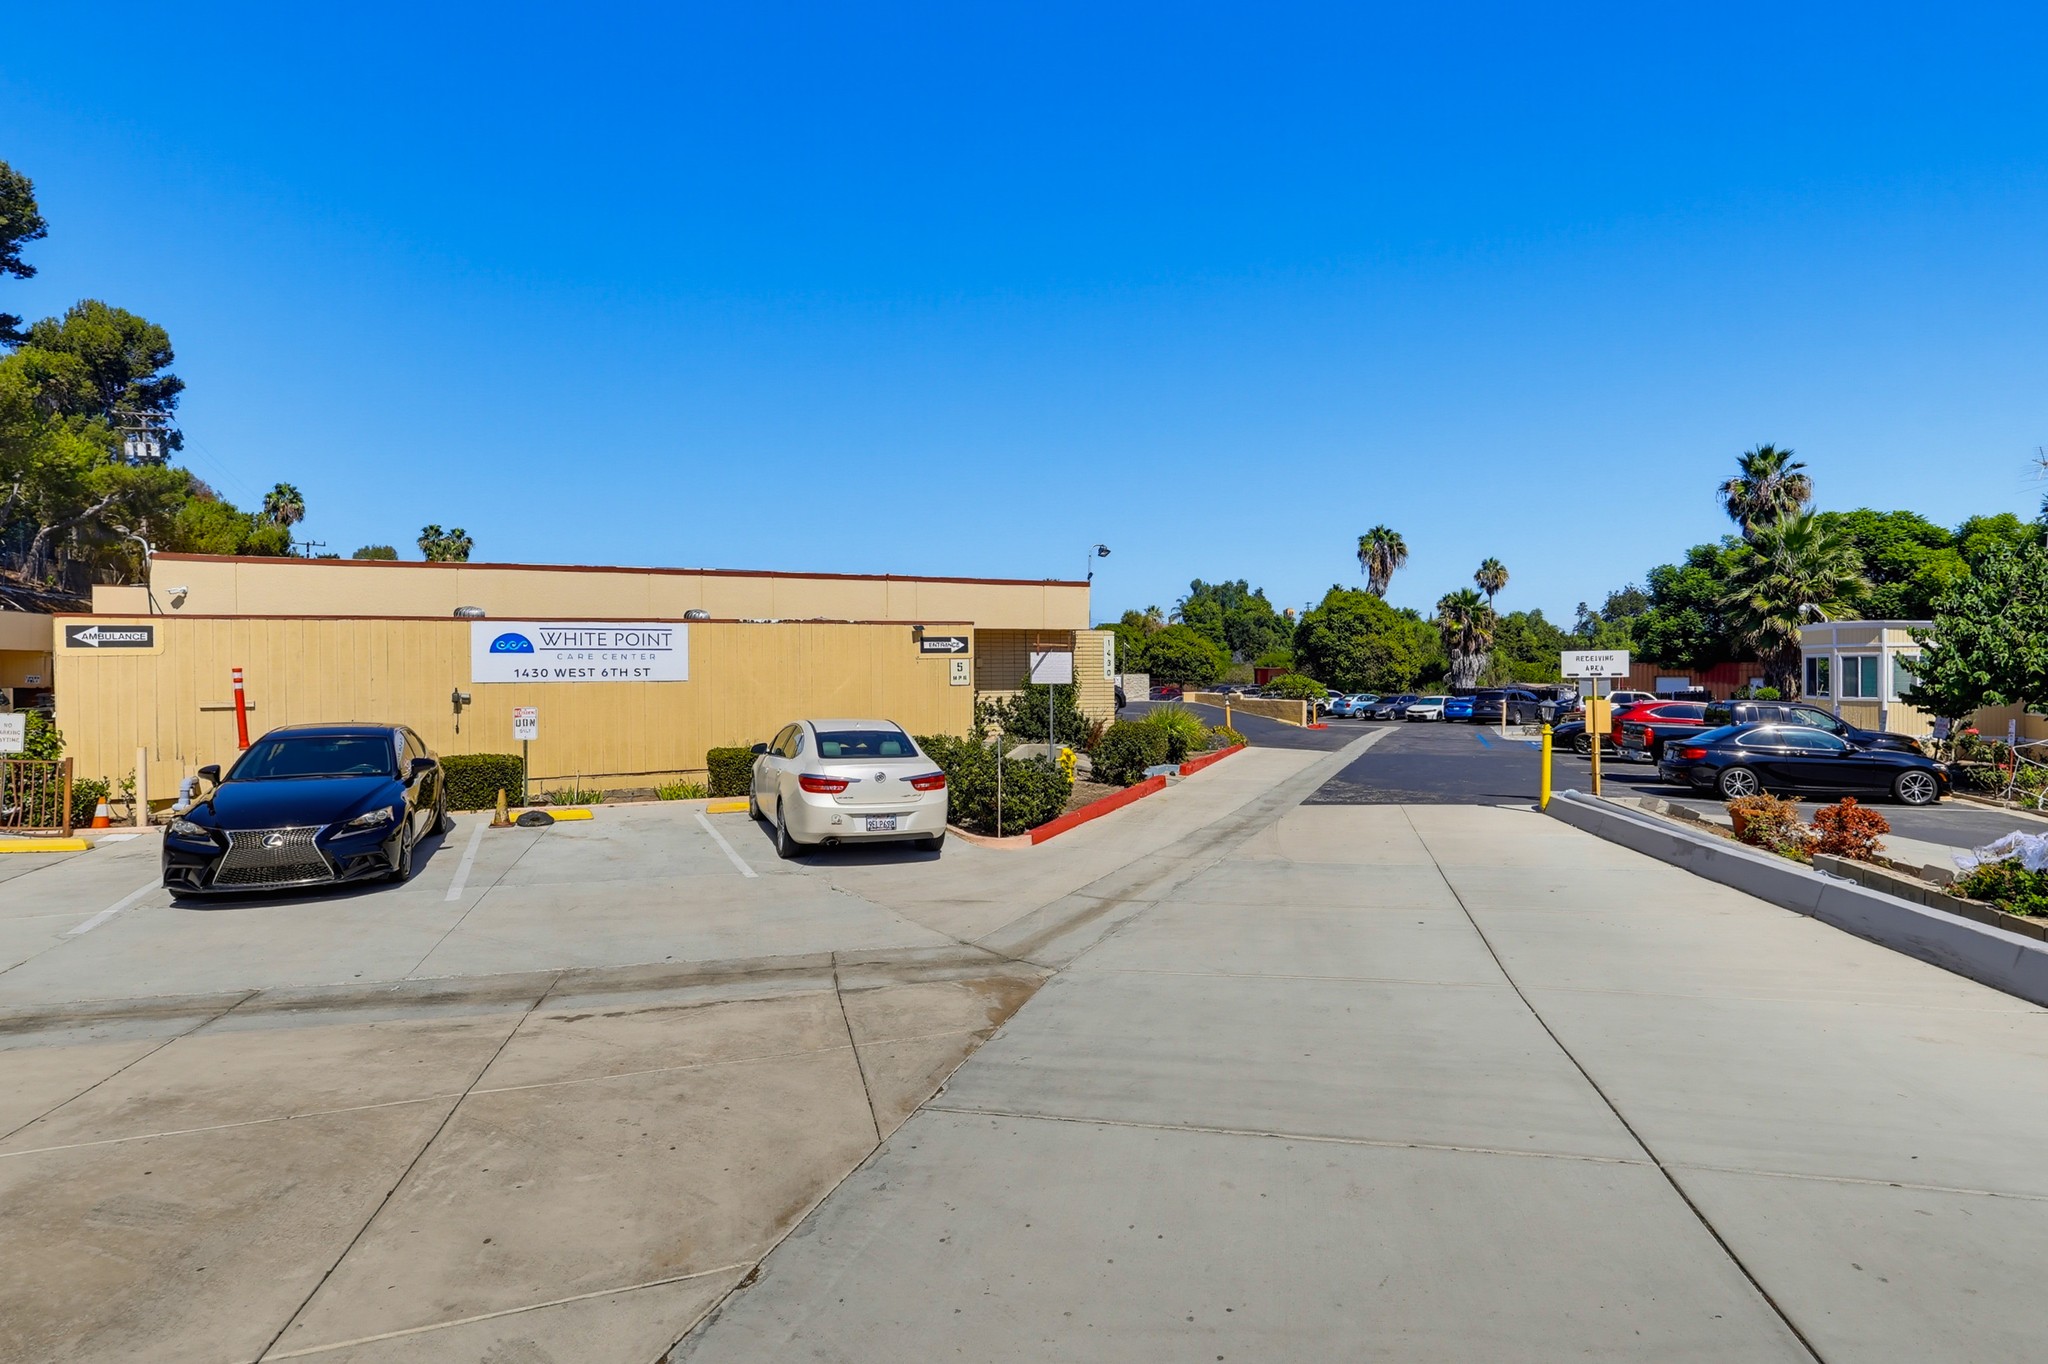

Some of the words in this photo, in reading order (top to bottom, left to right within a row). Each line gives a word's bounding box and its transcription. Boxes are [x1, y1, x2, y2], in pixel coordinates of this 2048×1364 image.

[81, 633, 147, 641] AMBULANCE
[540, 632, 607, 647] WHITE
[614, 632, 673, 647] POINT
[556, 653, 594, 661] CARE
[602, 653, 656, 661] CENTER
[956, 662, 963, 672] 5
[514, 668, 549, 678] 1430
[554, 668, 596, 678] WEST
[601, 668, 629, 678] 6TH
[633, 667, 651, 677] ST
